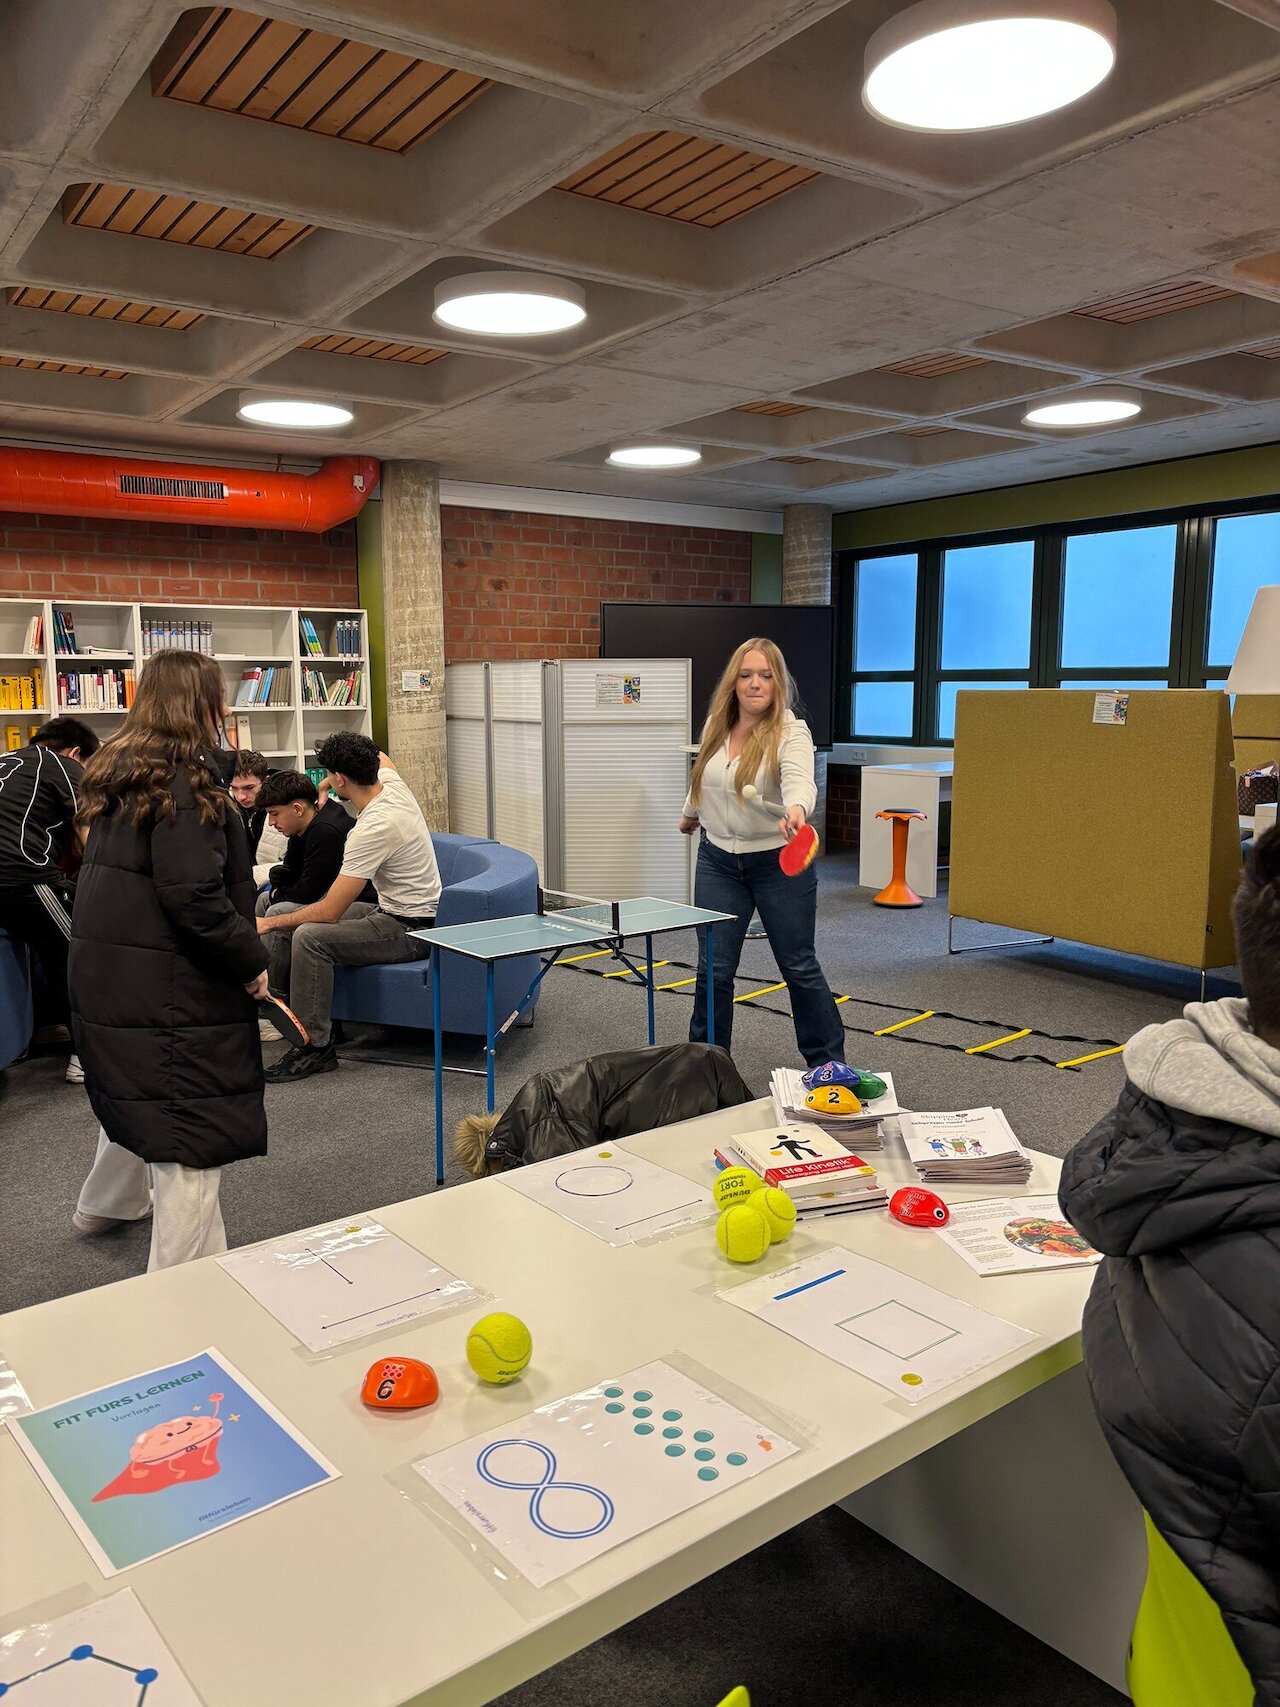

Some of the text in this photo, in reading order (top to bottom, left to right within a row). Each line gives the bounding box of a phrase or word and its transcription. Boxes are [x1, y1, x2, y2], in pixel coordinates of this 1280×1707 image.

[820, 1069, 834, 1082] 3
[828, 1091, 841, 1105] 2
[779, 1159, 850, 1175] Life Kinetik
[720, 1179, 745, 1192] FORT
[719, 1189, 751, 1202] DUNLOP
[376, 1378, 396, 1400] 6
[52, 1413, 82, 1429] FIT
[134, 1370, 205, 1400] LERNEN
[111, 1402, 161, 1423] Vorlagen
